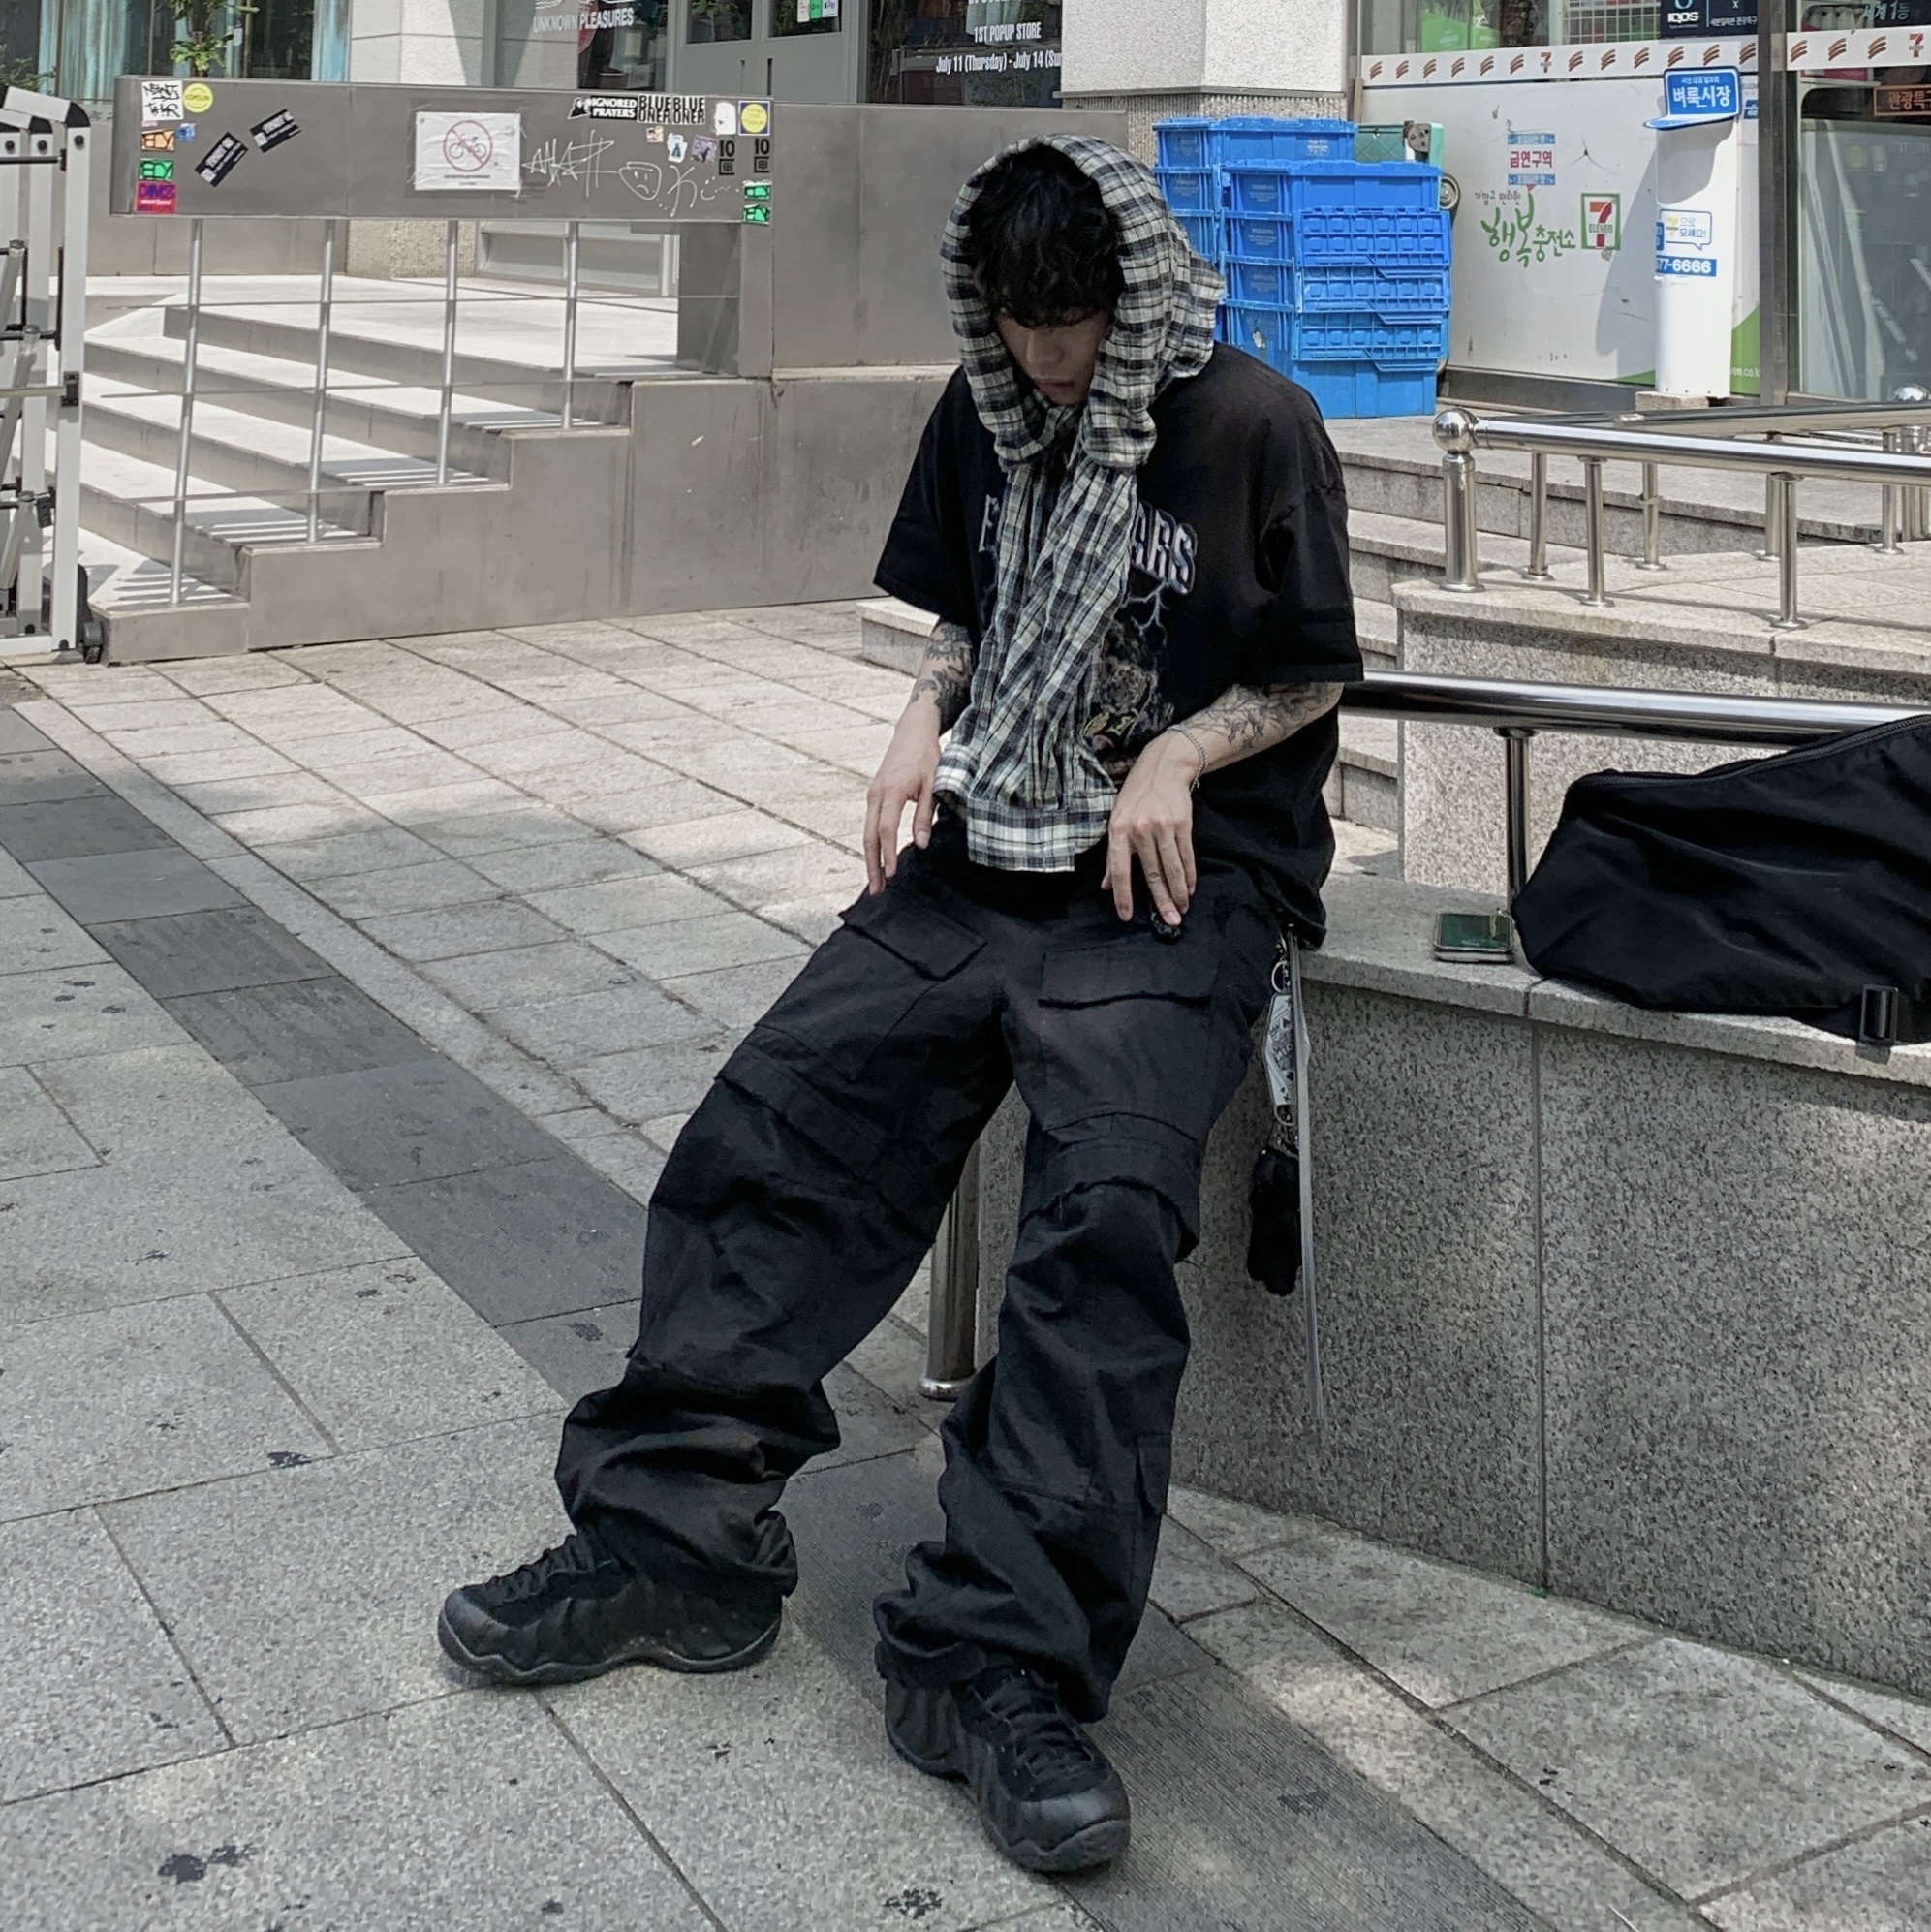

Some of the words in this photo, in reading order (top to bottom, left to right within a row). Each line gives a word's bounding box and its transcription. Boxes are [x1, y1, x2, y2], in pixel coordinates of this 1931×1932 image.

[533, 15, 577, 32] UNKNOWN
[579, 8, 635, 30] PLEASURES
[974, 26, 988, 43] 1ST
[989, 24, 1014, 41] POPUP
[1016, 21, 1042, 39] STORE
[936, 56, 951, 75] July
[953, 55, 962, 72] 11
[964, 52, 1007, 72] (Thursday)
[1013, 51, 1031, 71] July
[1033, 51, 1043, 68] 14
[592, 97, 637, 108] IGNORED
[1672, 85, 1731, 108] 벼룩시장
[593, 108, 636, 117] PRAYERS
[719, 140, 735, 157] 10
[755, 138, 770, 155] 10
[1510, 150, 1552, 169] 금연구역
